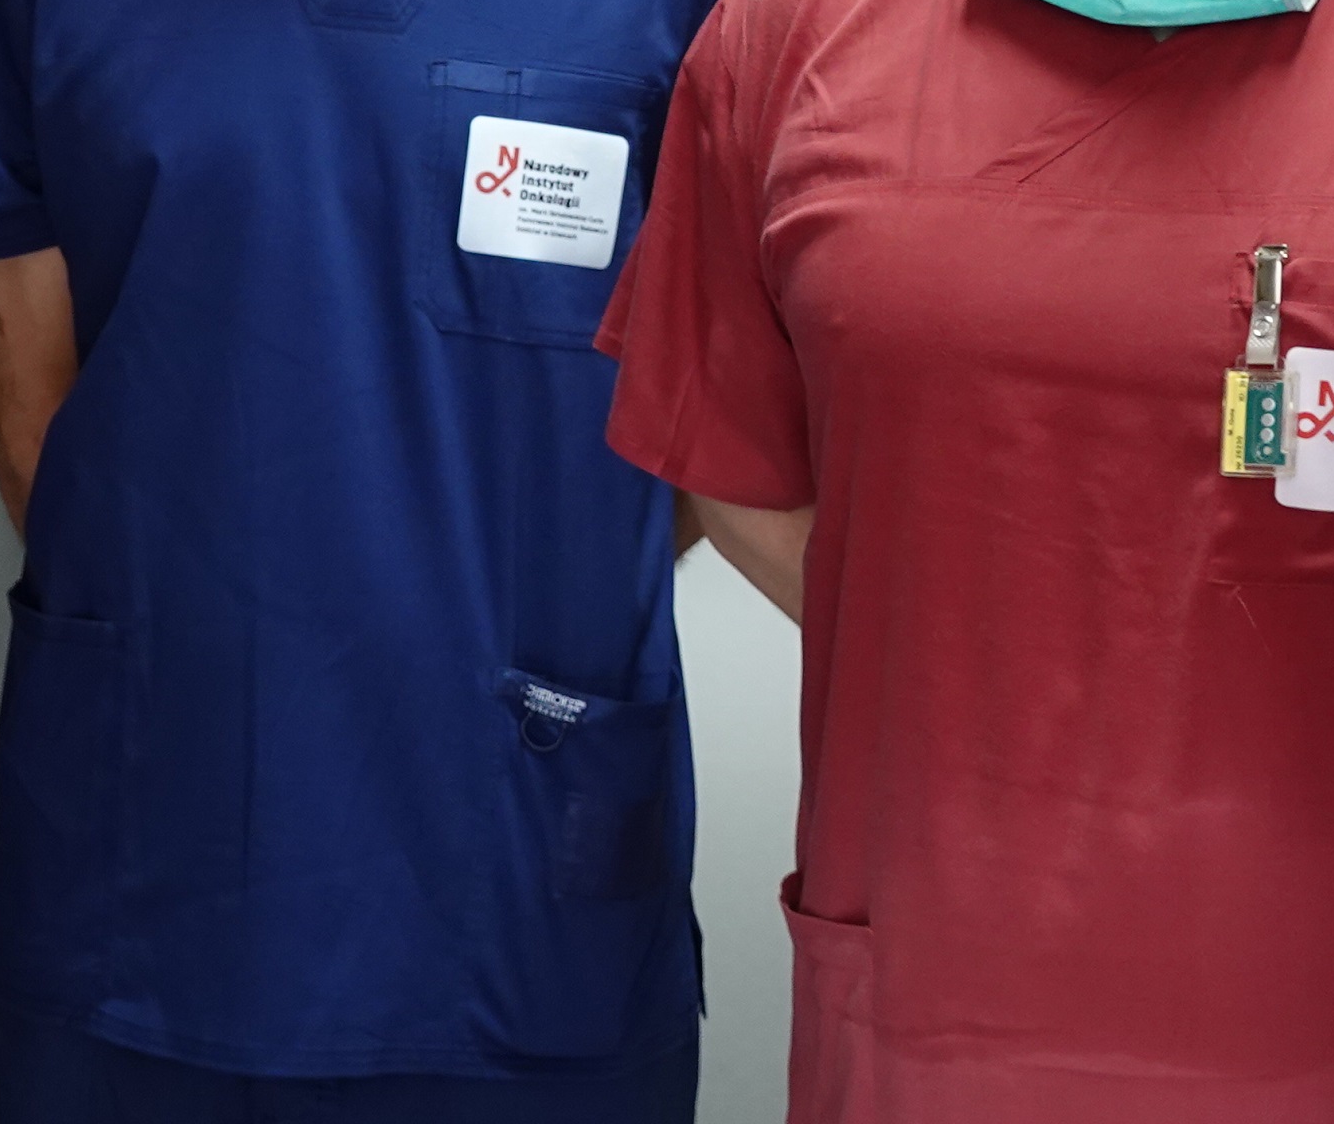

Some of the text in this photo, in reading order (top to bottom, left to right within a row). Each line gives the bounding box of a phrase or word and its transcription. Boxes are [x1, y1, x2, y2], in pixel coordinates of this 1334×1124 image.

[523, 159, 589, 180] Narodowy
[521, 174, 574, 192] Instytut
[519, 189, 581, 209] Onkologii
